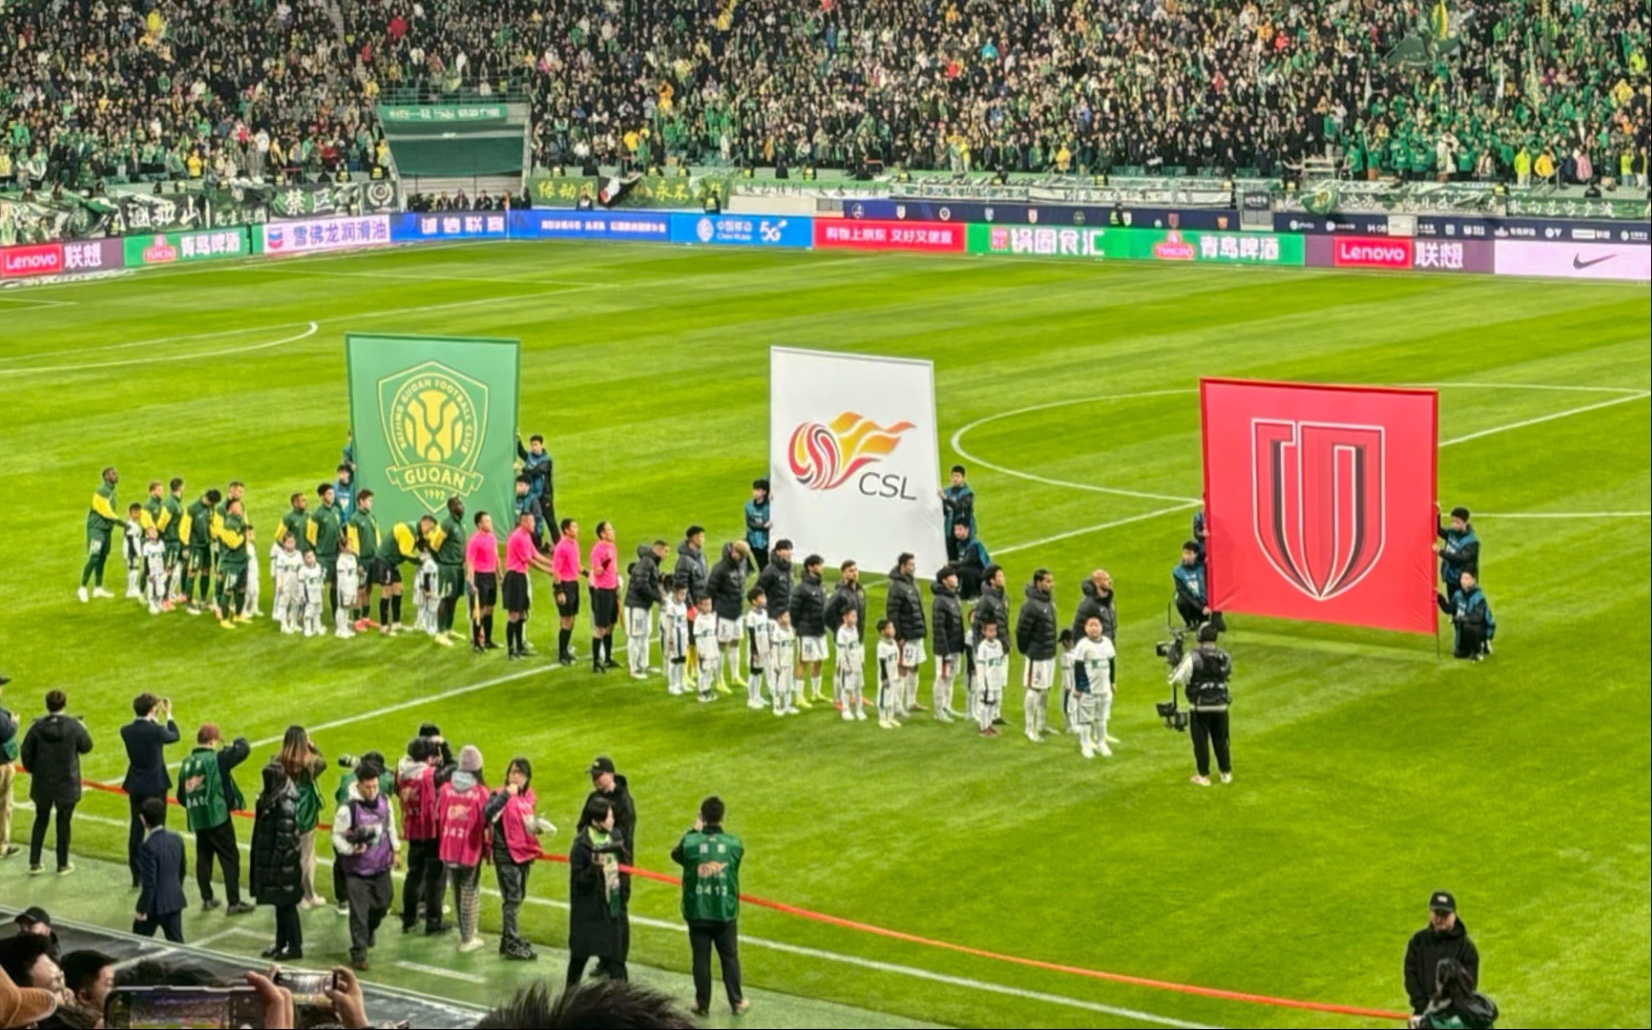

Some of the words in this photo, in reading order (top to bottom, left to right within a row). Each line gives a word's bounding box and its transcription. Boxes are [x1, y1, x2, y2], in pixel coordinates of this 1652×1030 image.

[180, 230, 240, 257] 青岛啤酒
[293, 219, 387, 246] 雪佛龙润滑油
[759, 220, 782, 242] 5G
[825, 226, 887, 241] 购物上京东
[889, 228, 953, 244] 又好又便宜
[1010, 227, 1105, 256] 锅圈食汇
[64, 242, 103, 269] 联想
[1199, 235, 1279, 260] 青岛啤酒
[1340, 242, 1405, 261] Lenovo
[1414, 241, 1464, 268] 联想
[5, 252, 58, 271] Lenovo
[403, 466, 466, 489] GUOAN
[858, 471, 917, 501] CSL
[423, 488, 446, 501] 1992
